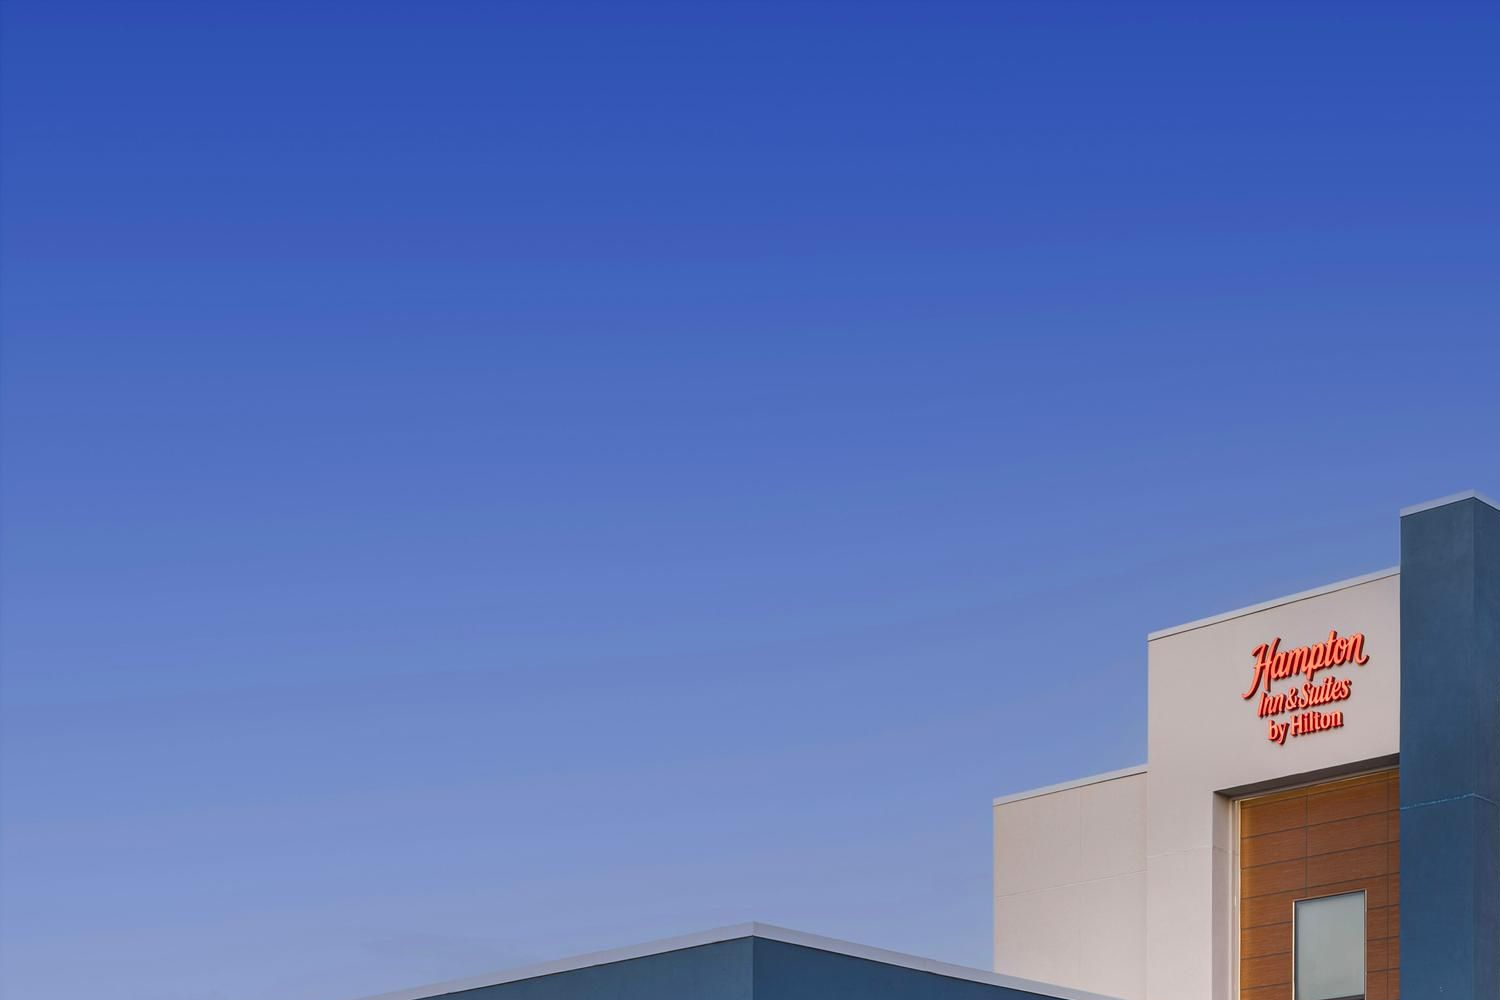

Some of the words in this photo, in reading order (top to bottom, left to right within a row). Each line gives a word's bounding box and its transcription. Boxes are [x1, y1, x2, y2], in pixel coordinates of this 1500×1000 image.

[1242, 629, 1369, 699] Hampton
[1268, 720, 1290, 745] by
[1290, 710, 1344, 737] Hilton
